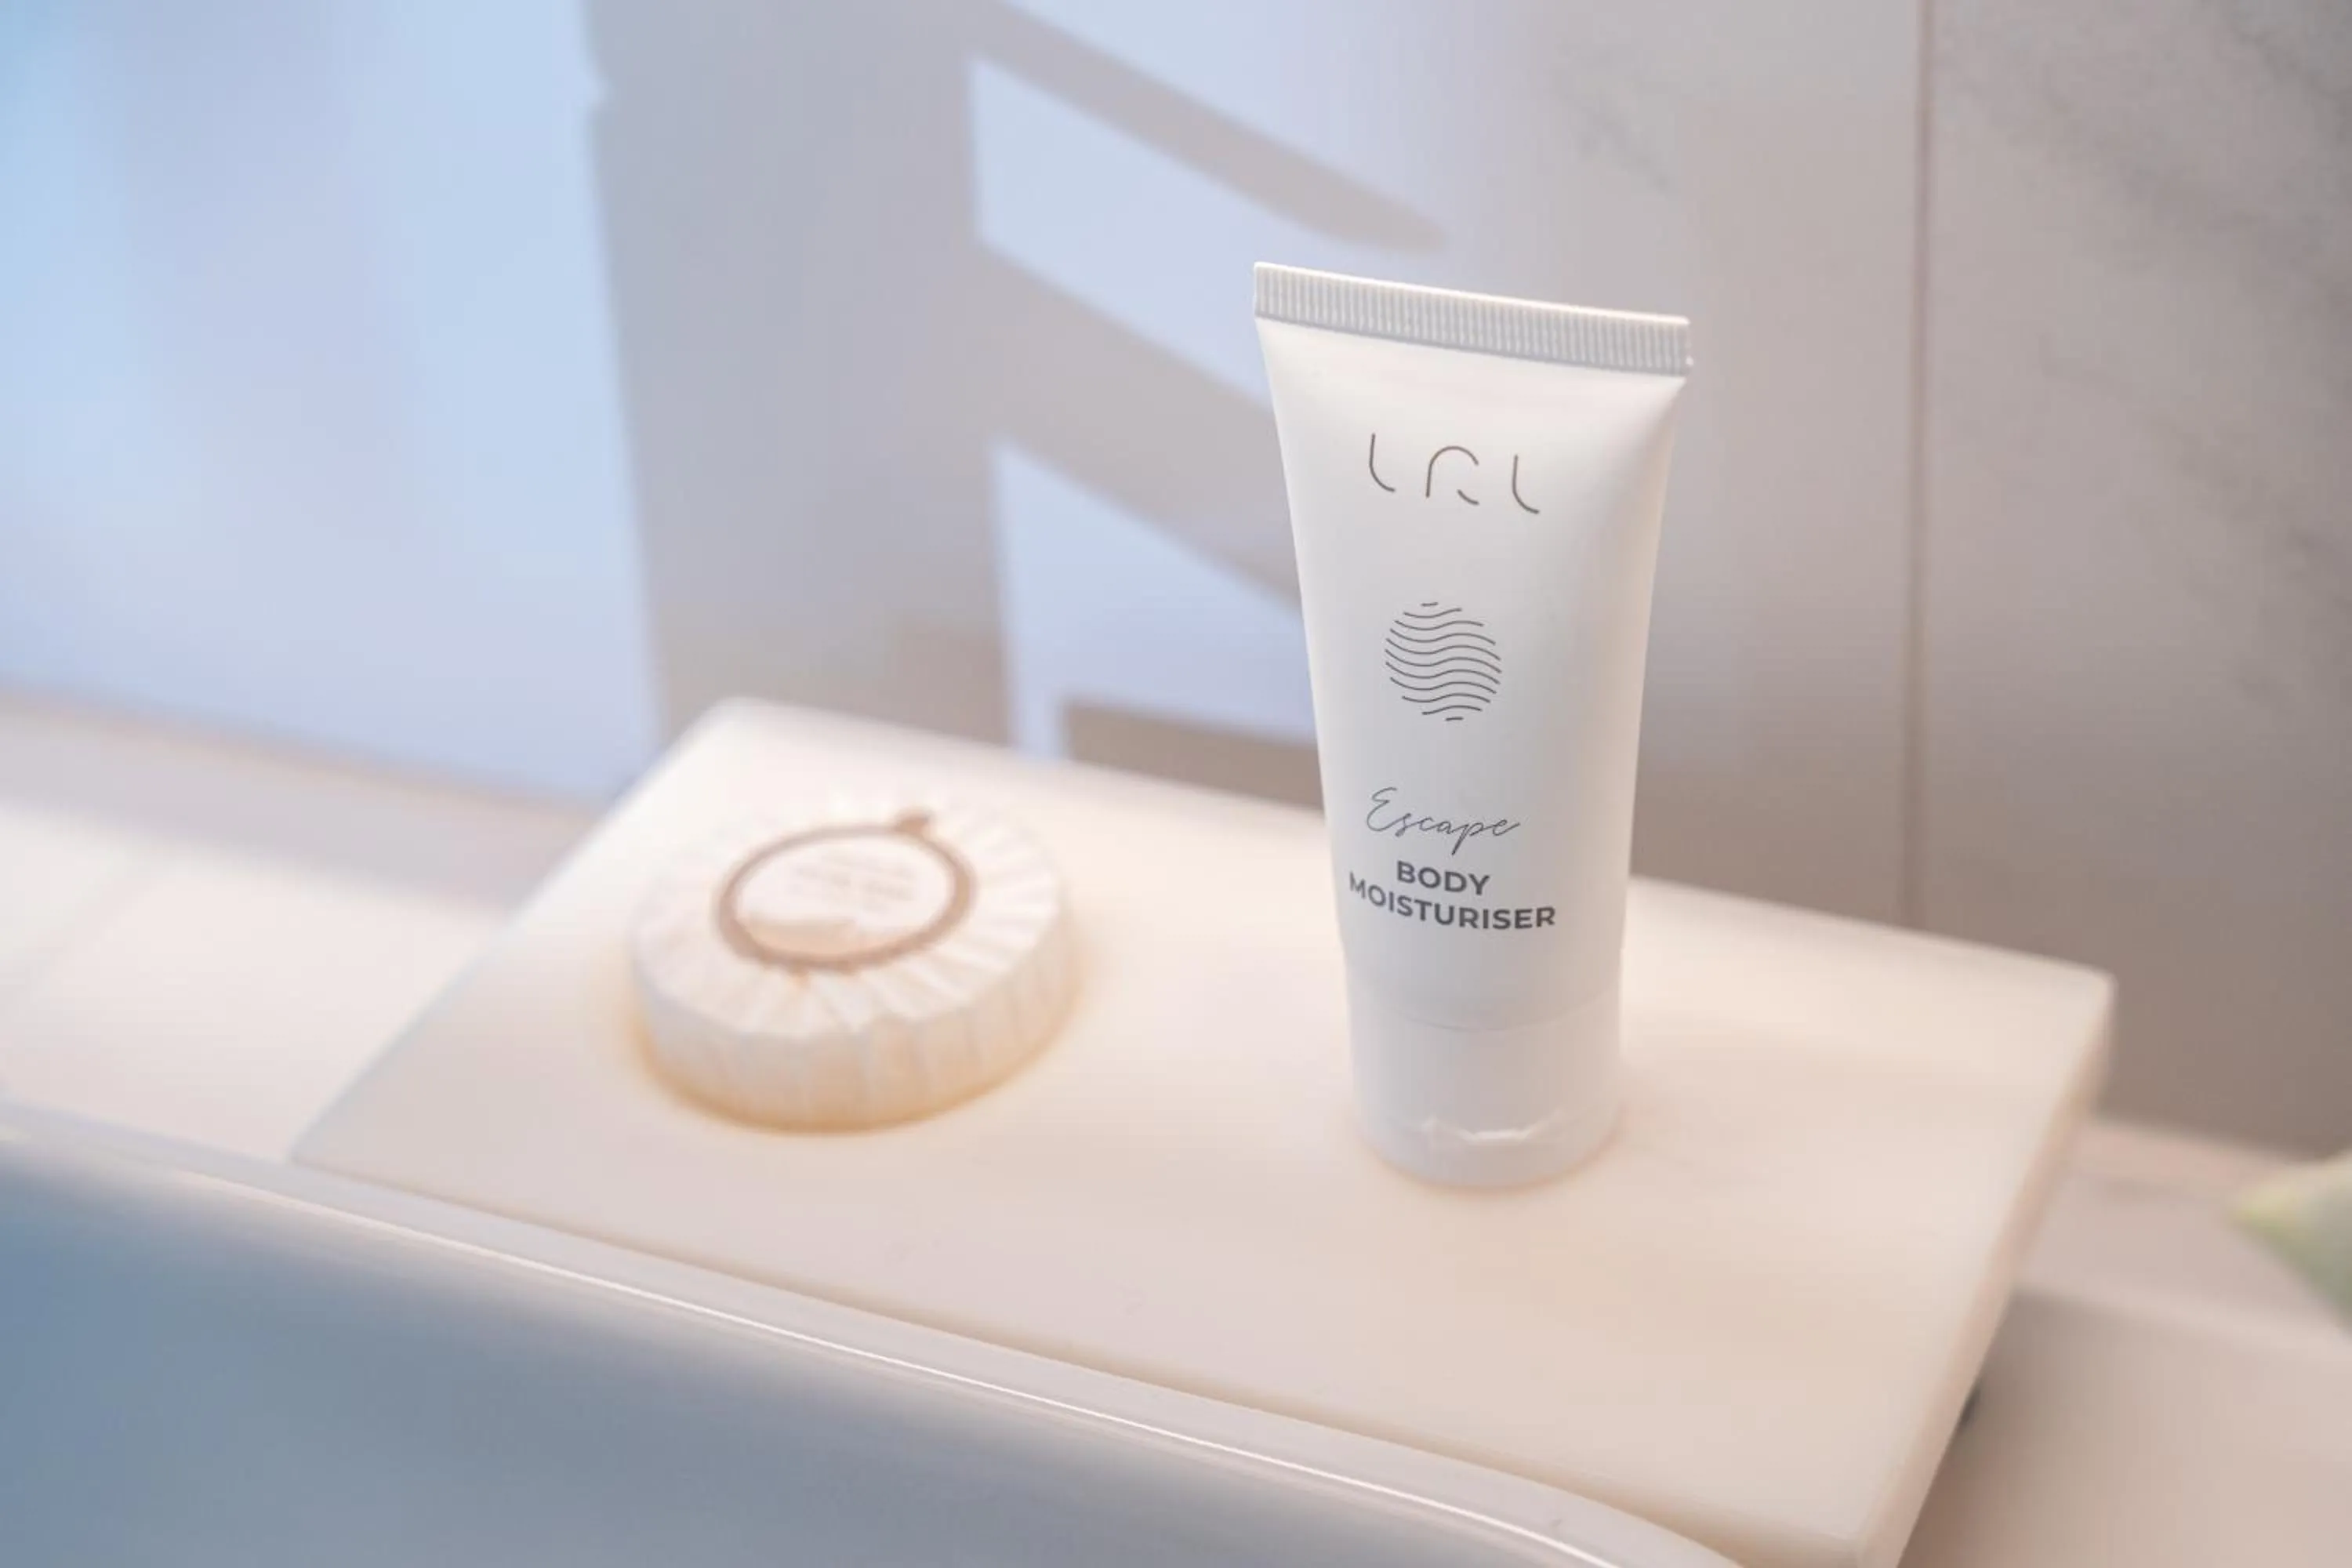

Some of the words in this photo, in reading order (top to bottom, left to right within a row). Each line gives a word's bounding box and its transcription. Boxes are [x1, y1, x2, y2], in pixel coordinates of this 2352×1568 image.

[1366, 786, 1521, 856] Escape
[1348, 870, 1557, 930] MOISTURISER
[1396, 859, 1491, 896] BODY
